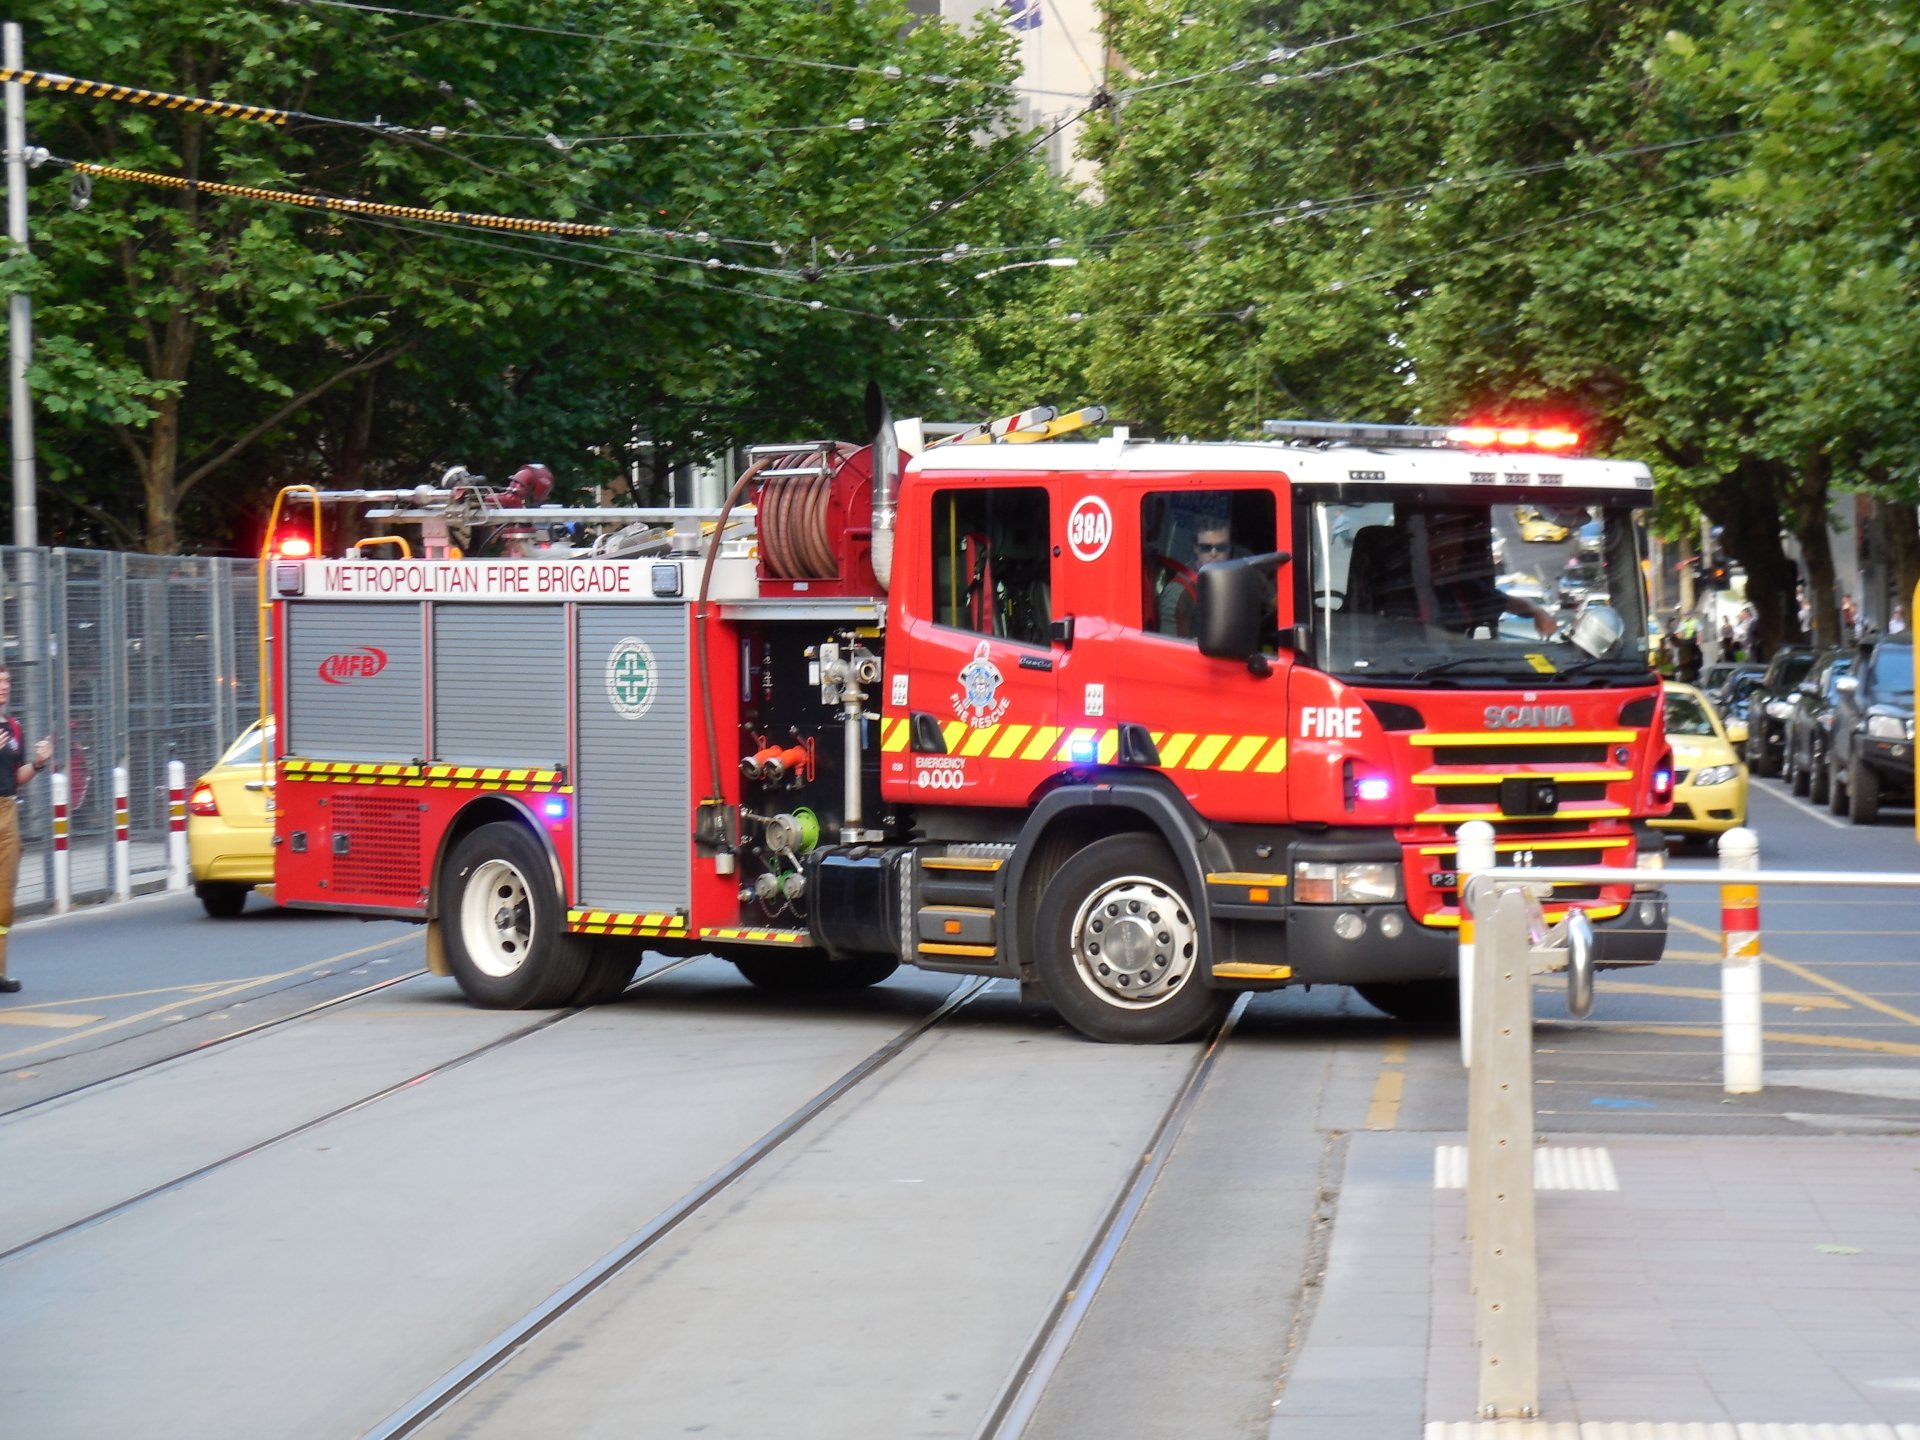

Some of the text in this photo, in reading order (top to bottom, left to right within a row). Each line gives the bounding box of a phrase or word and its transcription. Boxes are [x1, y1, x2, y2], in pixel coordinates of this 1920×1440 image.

[1073, 512, 1105, 545] 38A
[325, 566, 631, 592] METROPOLITAN FIRE BRIGADE
[331, 655, 376, 678] MFB
[950, 693, 1010, 729] FIRE RESCUE
[1301, 707, 1362, 738] FIRE
[1484, 705, 1575, 729] SCANIA
[915, 757, 966, 769] EMERGENCY
